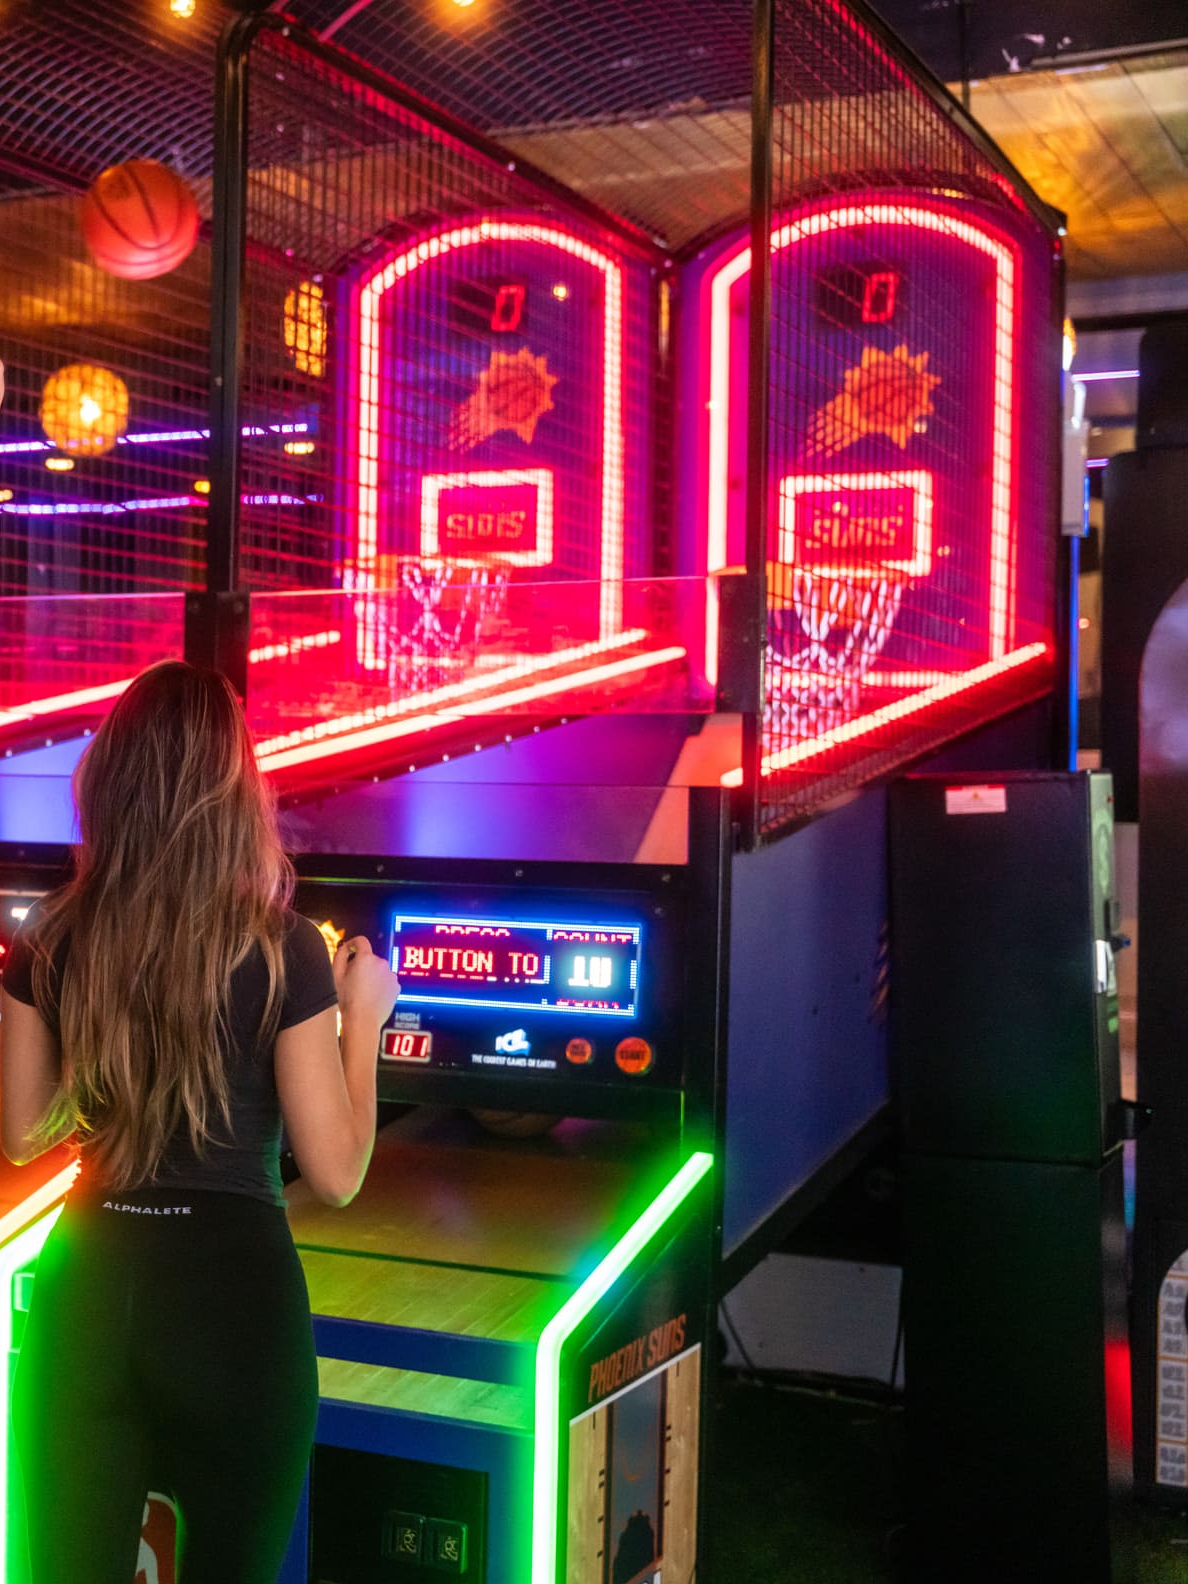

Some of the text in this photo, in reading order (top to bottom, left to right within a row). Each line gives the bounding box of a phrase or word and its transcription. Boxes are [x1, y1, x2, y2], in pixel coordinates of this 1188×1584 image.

[491, 284, 525, 331] 0
[403, 946, 539, 975] BUTTON TO
[102, 1201, 192, 1214] ALPHALETE
[588, 1313, 687, 1403] PHOENIX SUNS
